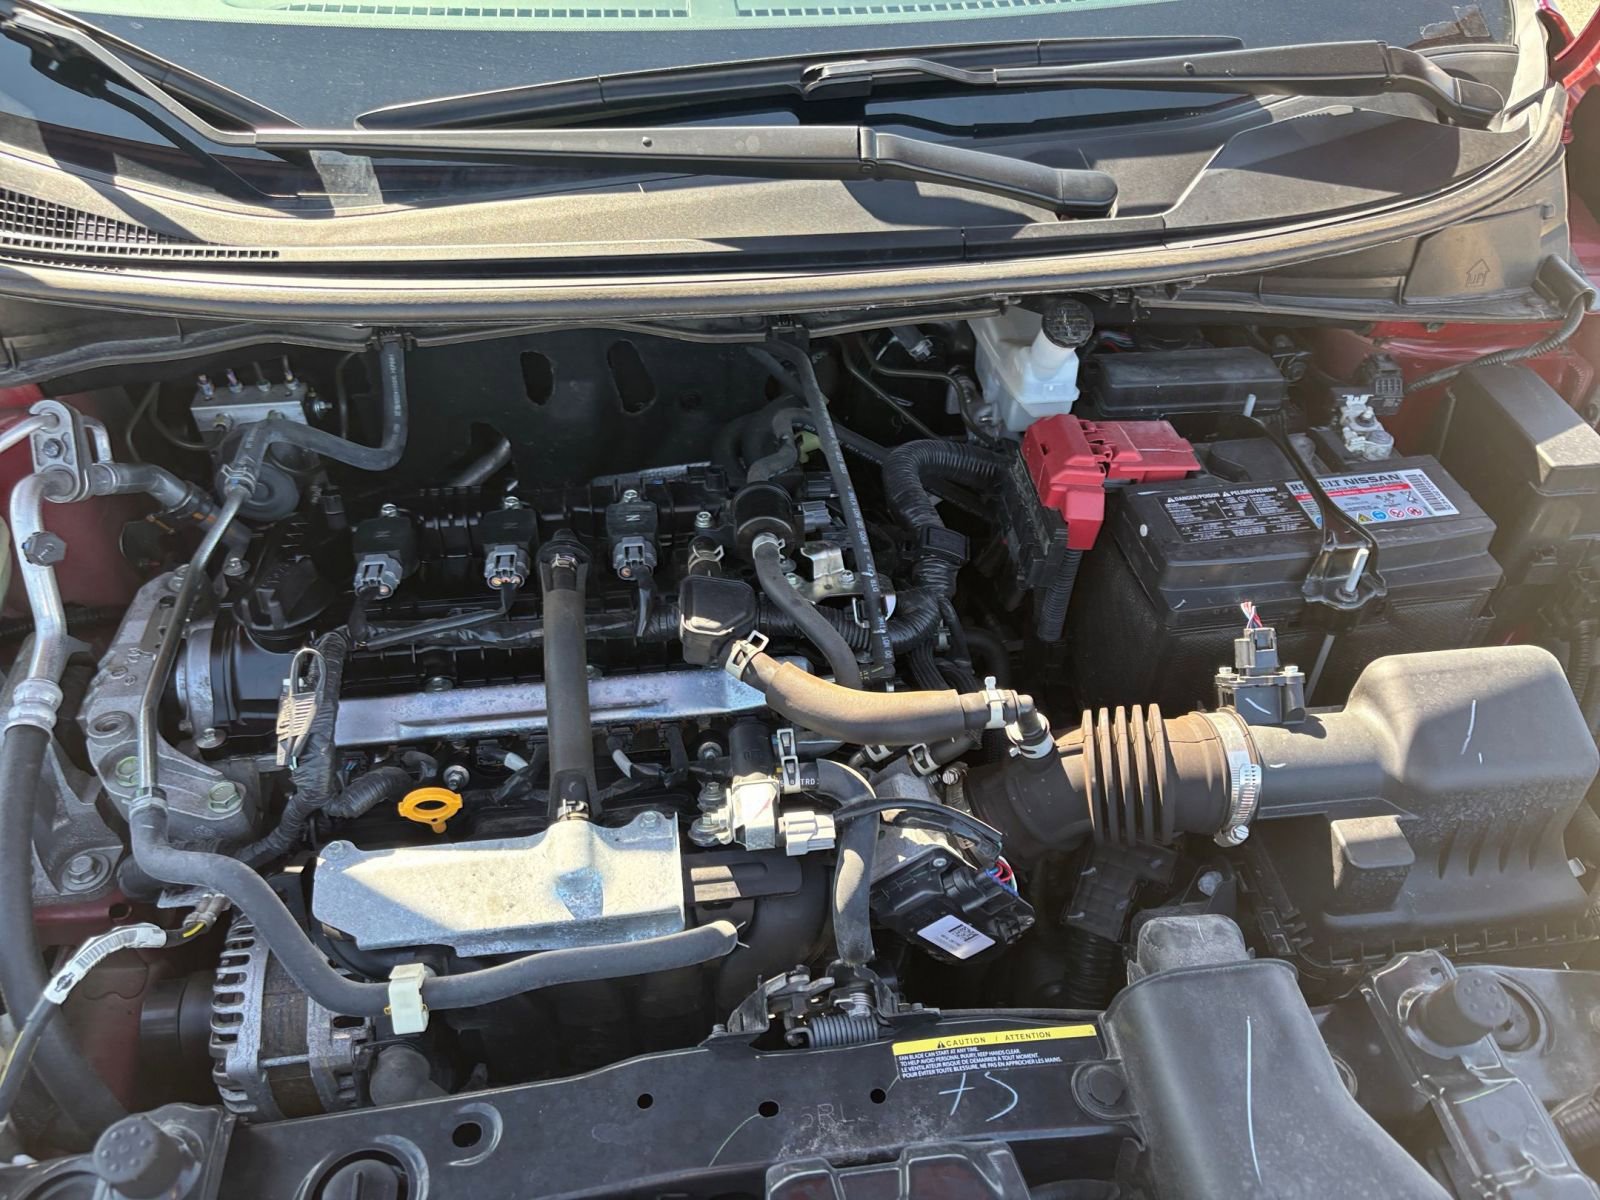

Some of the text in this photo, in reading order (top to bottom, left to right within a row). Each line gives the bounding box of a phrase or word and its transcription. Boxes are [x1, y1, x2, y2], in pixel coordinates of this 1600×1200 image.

[1290, 479, 1343, 491] REULT
[1343, 473, 1400, 485] NISSAN
[946, 1037, 986, 1047] CAUTION
[1005, 1031, 1051, 1041] ATTENTION
[936, 1054, 959, 1062] PERSONAL
[908, 1062, 942, 1072] VENTILATEUR
[942, 1060, 960, 1068] RISQUE
[936, 1066, 953, 1074] TOUTE
[1006, 1059, 1035, 1067] APPROCHER
